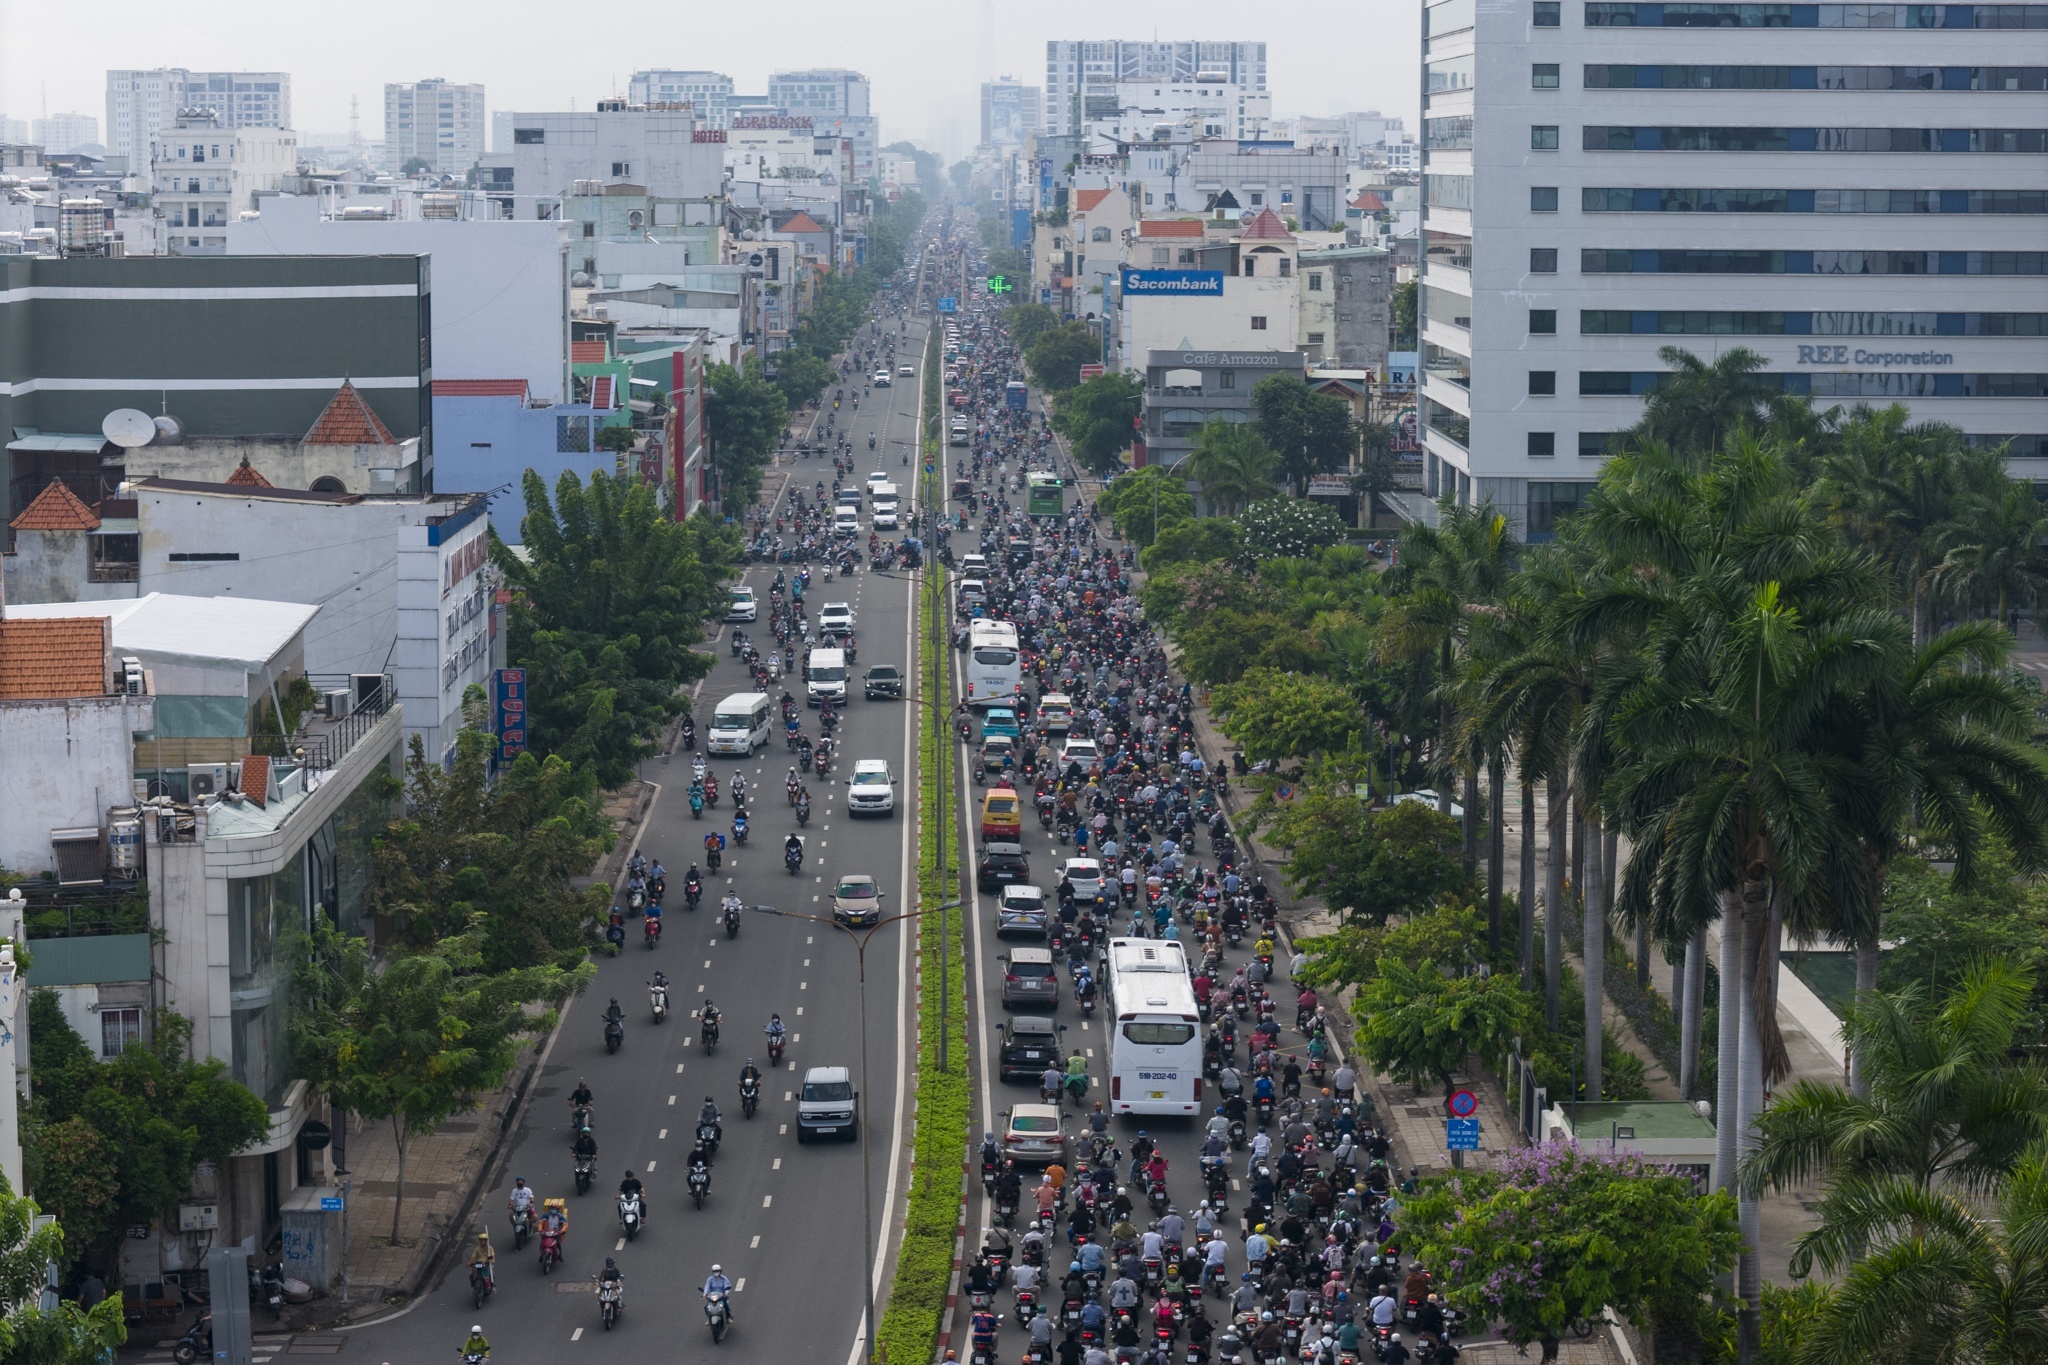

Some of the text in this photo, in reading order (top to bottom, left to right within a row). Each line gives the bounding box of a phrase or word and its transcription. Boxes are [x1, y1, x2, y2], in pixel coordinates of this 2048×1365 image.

[693, 130, 727, 143] HOTEL
[1127, 273, 1219, 291] Sacombank
[1183, 352, 1279, 365] Café Amazon
[1797, 344, 1954, 367] REE Corporation
[501, 670, 524, 758] BIGFAN
